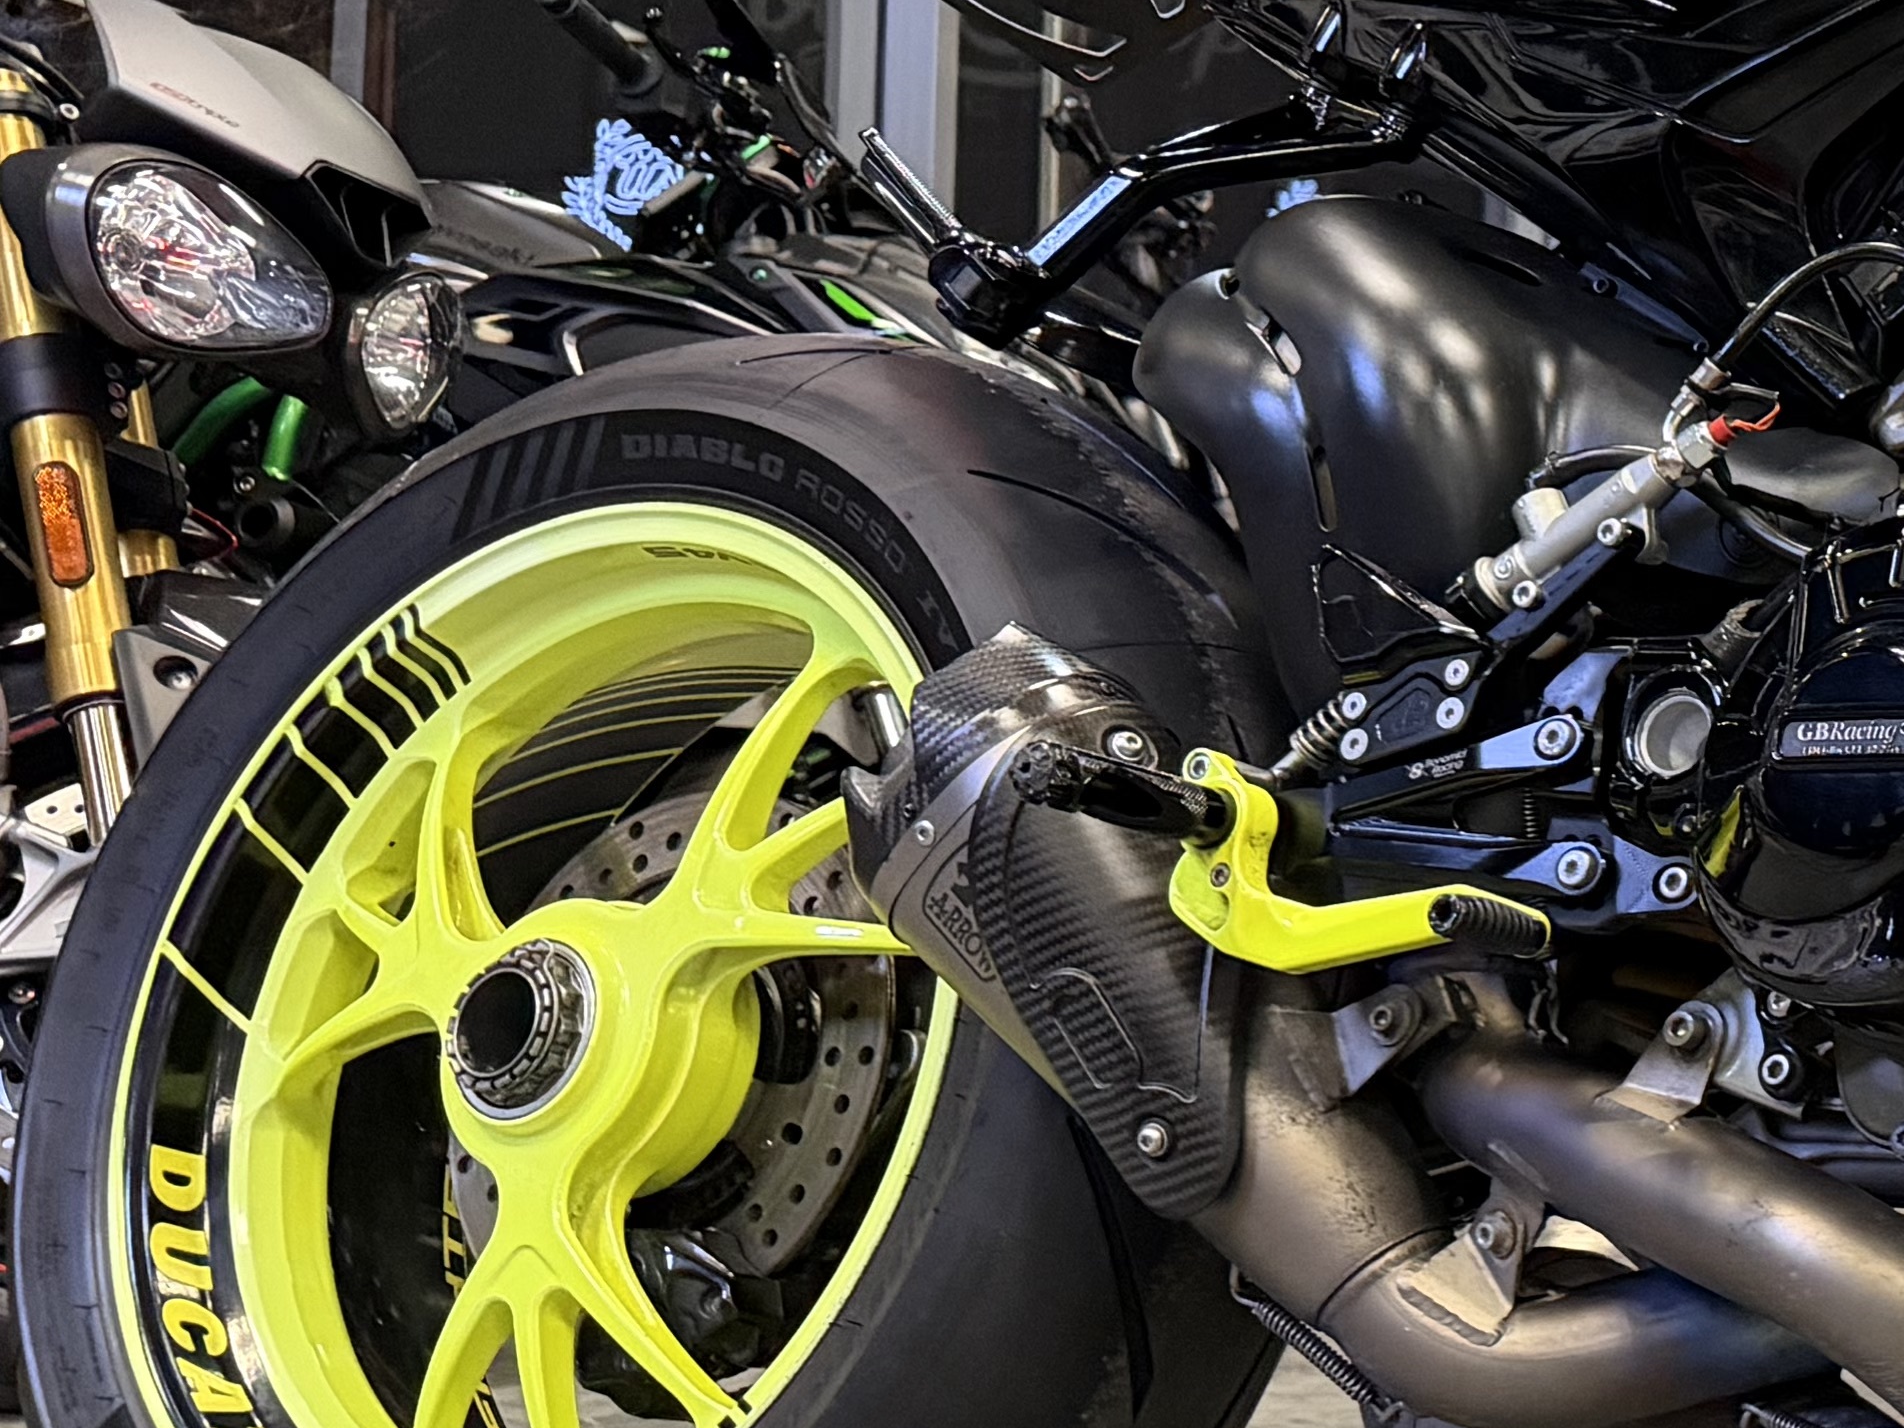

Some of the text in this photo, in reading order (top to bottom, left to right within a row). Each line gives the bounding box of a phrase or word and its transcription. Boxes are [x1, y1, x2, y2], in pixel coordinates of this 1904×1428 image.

[620, 433, 787, 482] DIABLO
[794, 467, 908, 574] ROSSO
[1796, 721, 1898, 744] GBRacing
